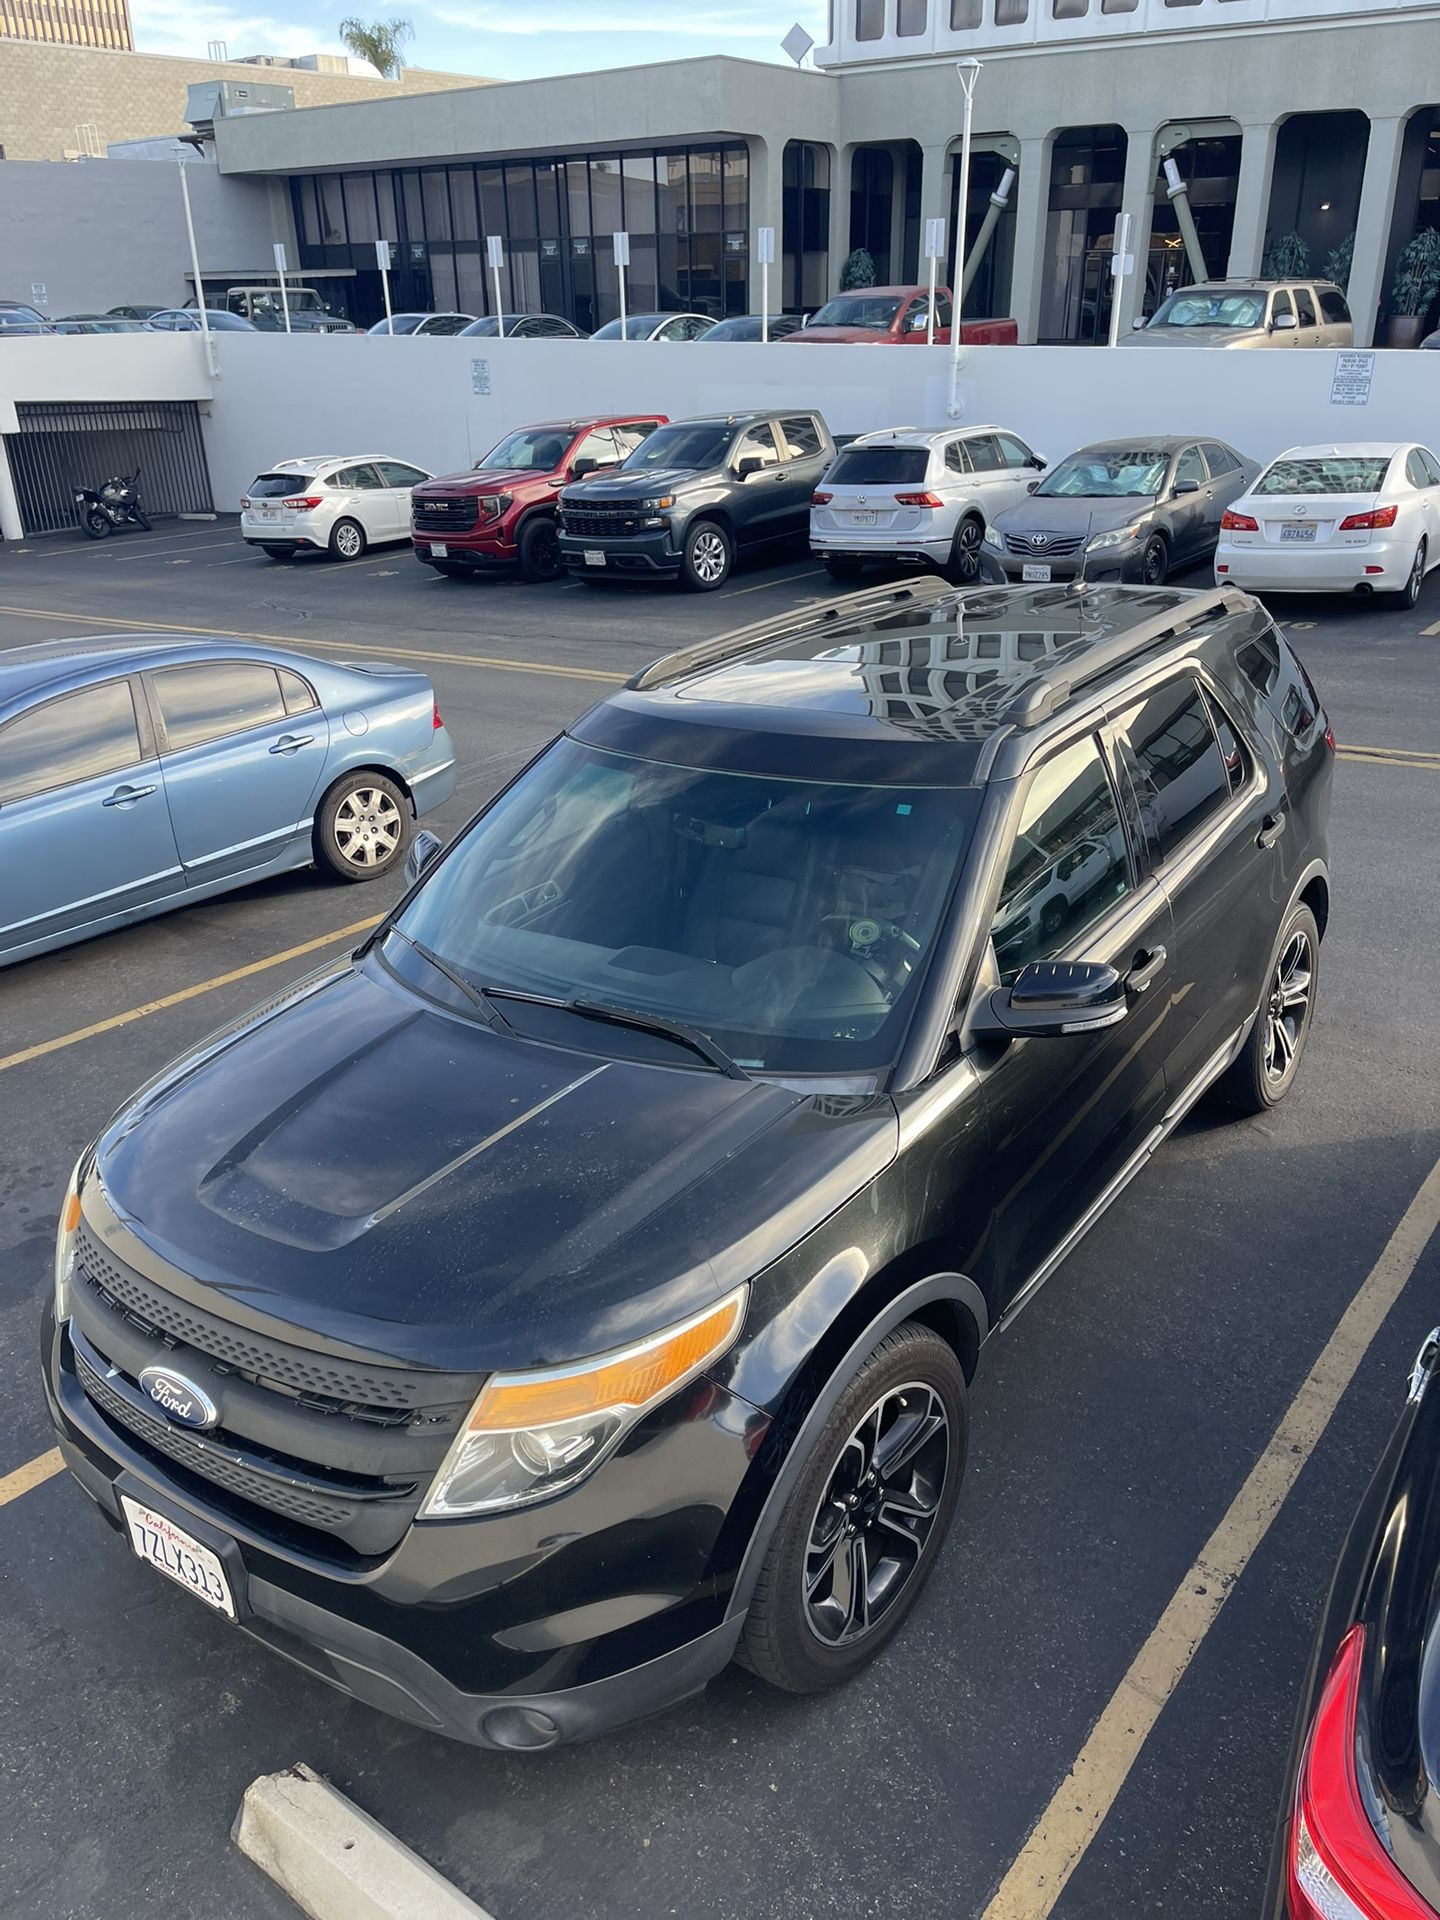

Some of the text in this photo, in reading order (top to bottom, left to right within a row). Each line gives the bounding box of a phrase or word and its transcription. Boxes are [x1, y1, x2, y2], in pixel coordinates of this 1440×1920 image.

[150, 1378, 193, 1418] Ford
[145, 1513, 199, 1553] California
[134, 1522, 225, 1602] 7ZLX313
